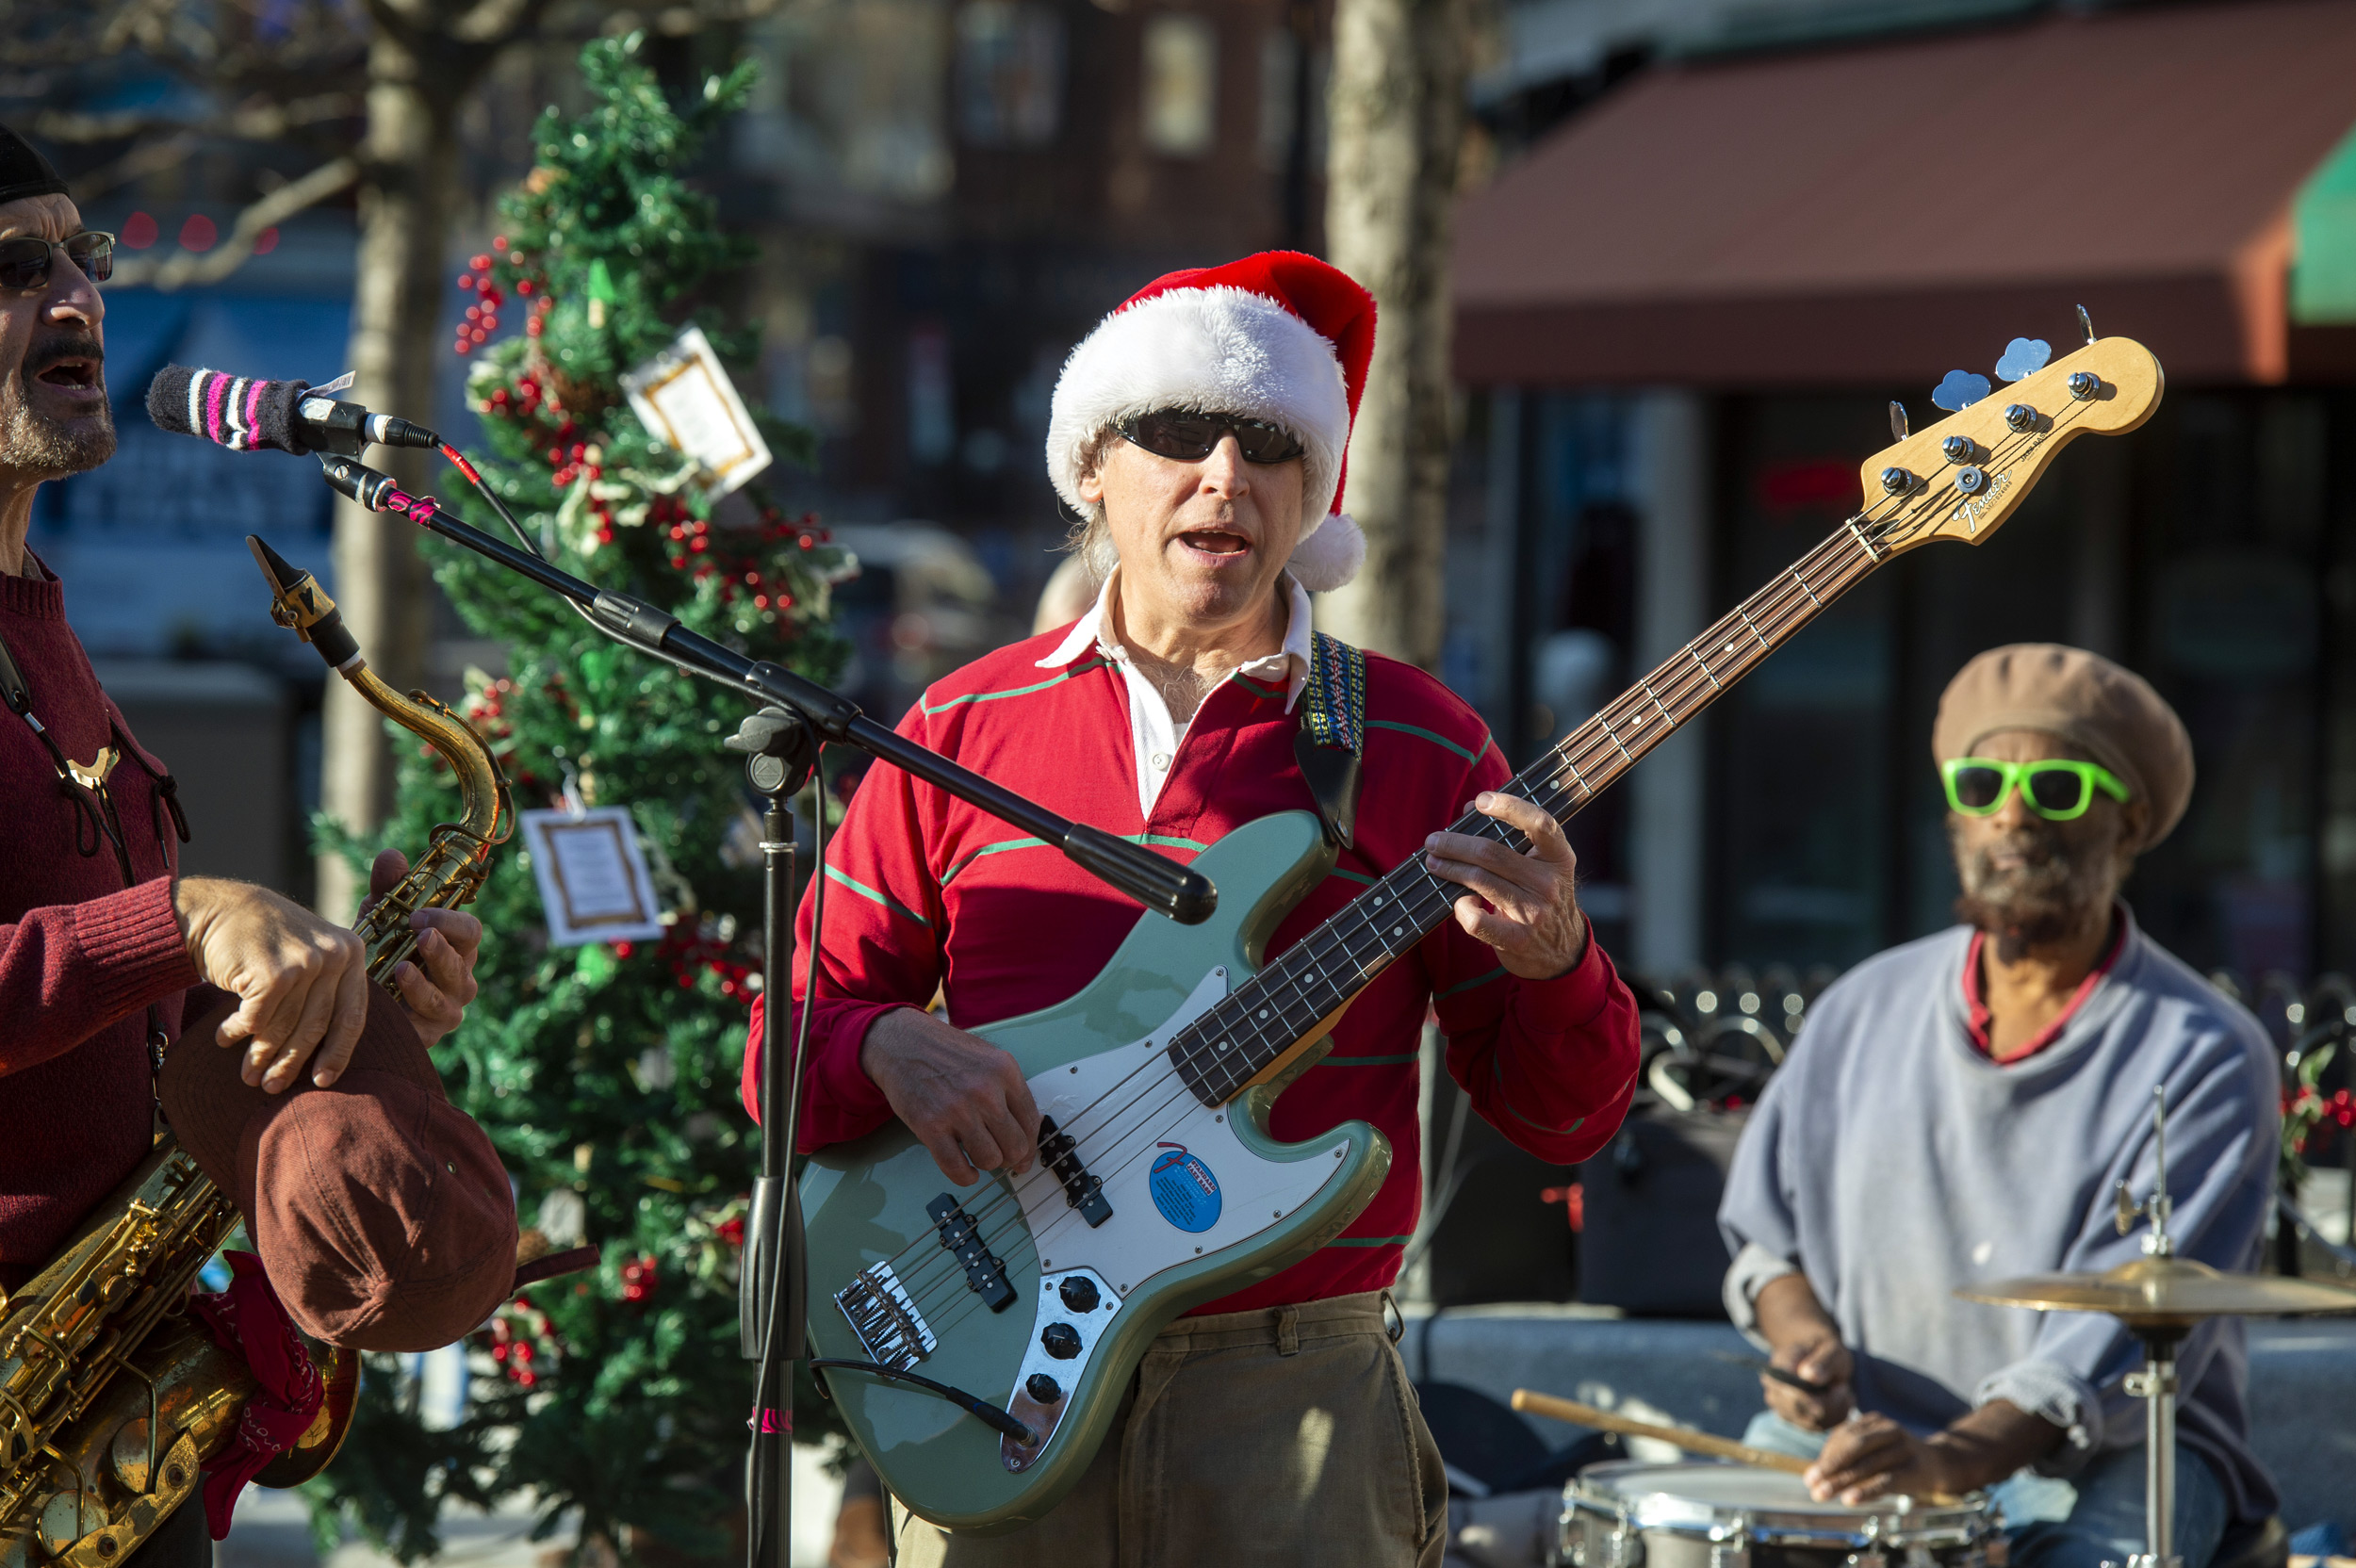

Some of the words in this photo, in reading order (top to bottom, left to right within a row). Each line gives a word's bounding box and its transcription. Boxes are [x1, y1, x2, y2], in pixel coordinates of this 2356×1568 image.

[1186, 1165, 1200, 1181] JAZZ
[1198, 1179, 1212, 1195] BASS
[1191, 1160, 1216, 1191] STANDARD
